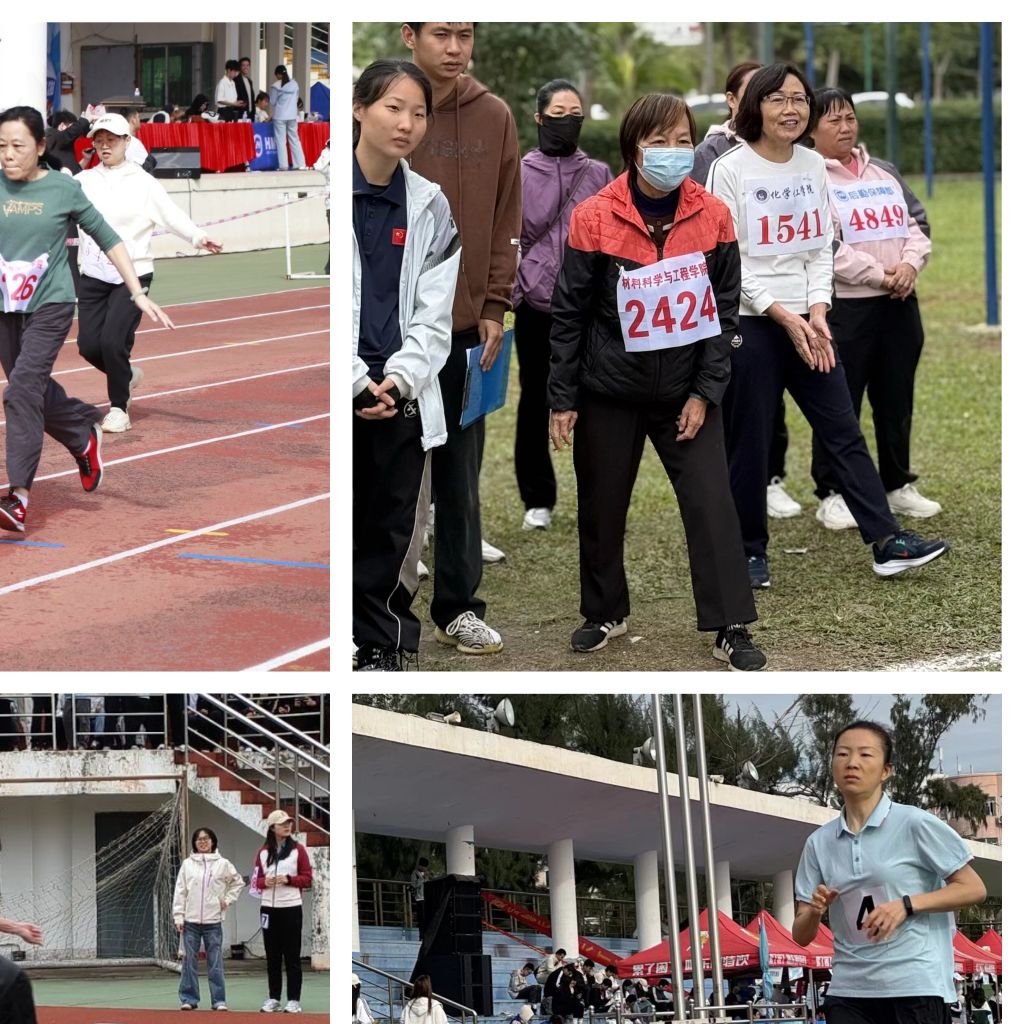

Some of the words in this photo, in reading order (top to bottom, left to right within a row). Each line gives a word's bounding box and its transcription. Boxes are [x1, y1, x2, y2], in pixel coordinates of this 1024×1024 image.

[757, 208, 824, 245] 1541
[849, 204, 904, 231] 4849
[622, 262, 708, 290] 材料科学与工程学院
[625, 285, 716, 338] 2424
[632, 960, 671, 976] 累了困
